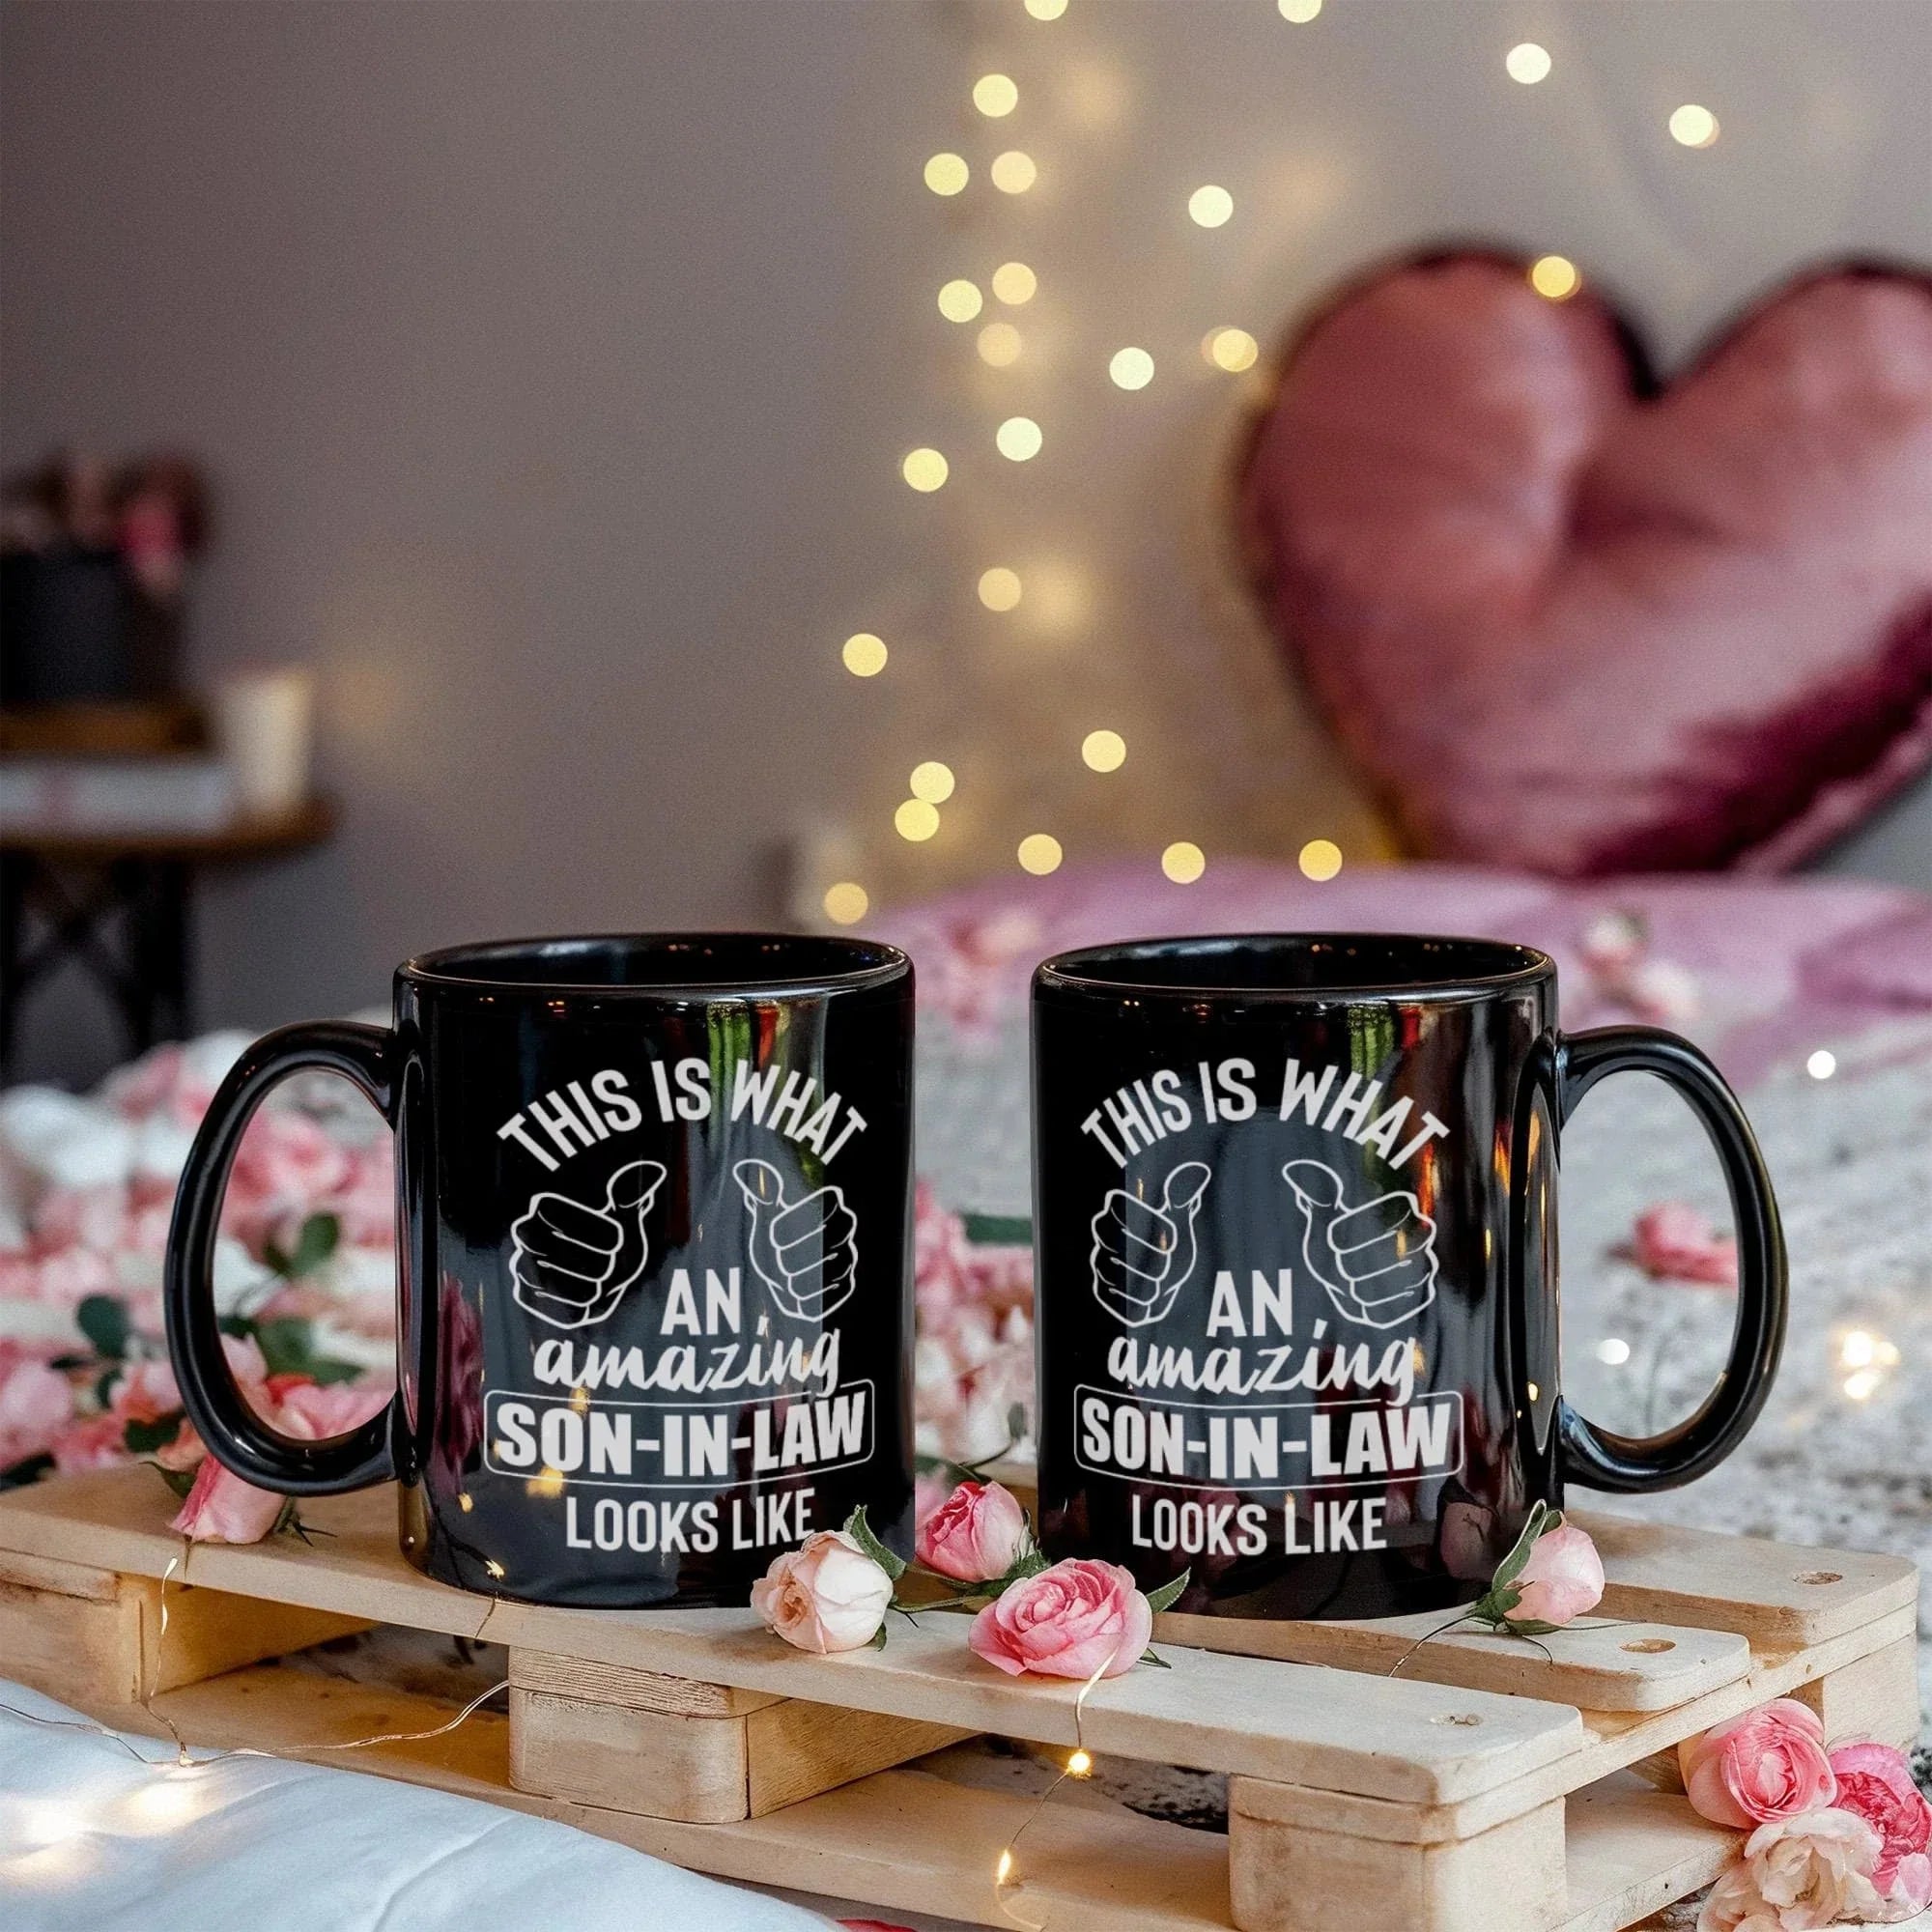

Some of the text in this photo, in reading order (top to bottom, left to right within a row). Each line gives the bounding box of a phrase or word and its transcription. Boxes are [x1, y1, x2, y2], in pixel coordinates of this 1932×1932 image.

[497, 1058, 867, 1172] THIS IS WHAT
[1080, 1058, 1449, 1170] THIS IS WHAT
[660, 1267, 741, 1335] AN
[1207, 1268, 1293, 1337] AN
[533, 1315, 840, 1398] amazing
[1107, 1319, 1416, 1406] amazing
[497, 1391, 867, 1476] SON-IN-LAW
[1082, 1397, 1450, 1479] SON-IN-LAW
[566, 1488, 815, 1553] LOOKS LIKE
[1132, 1493, 1387, 1555] LOOKS LIKE
